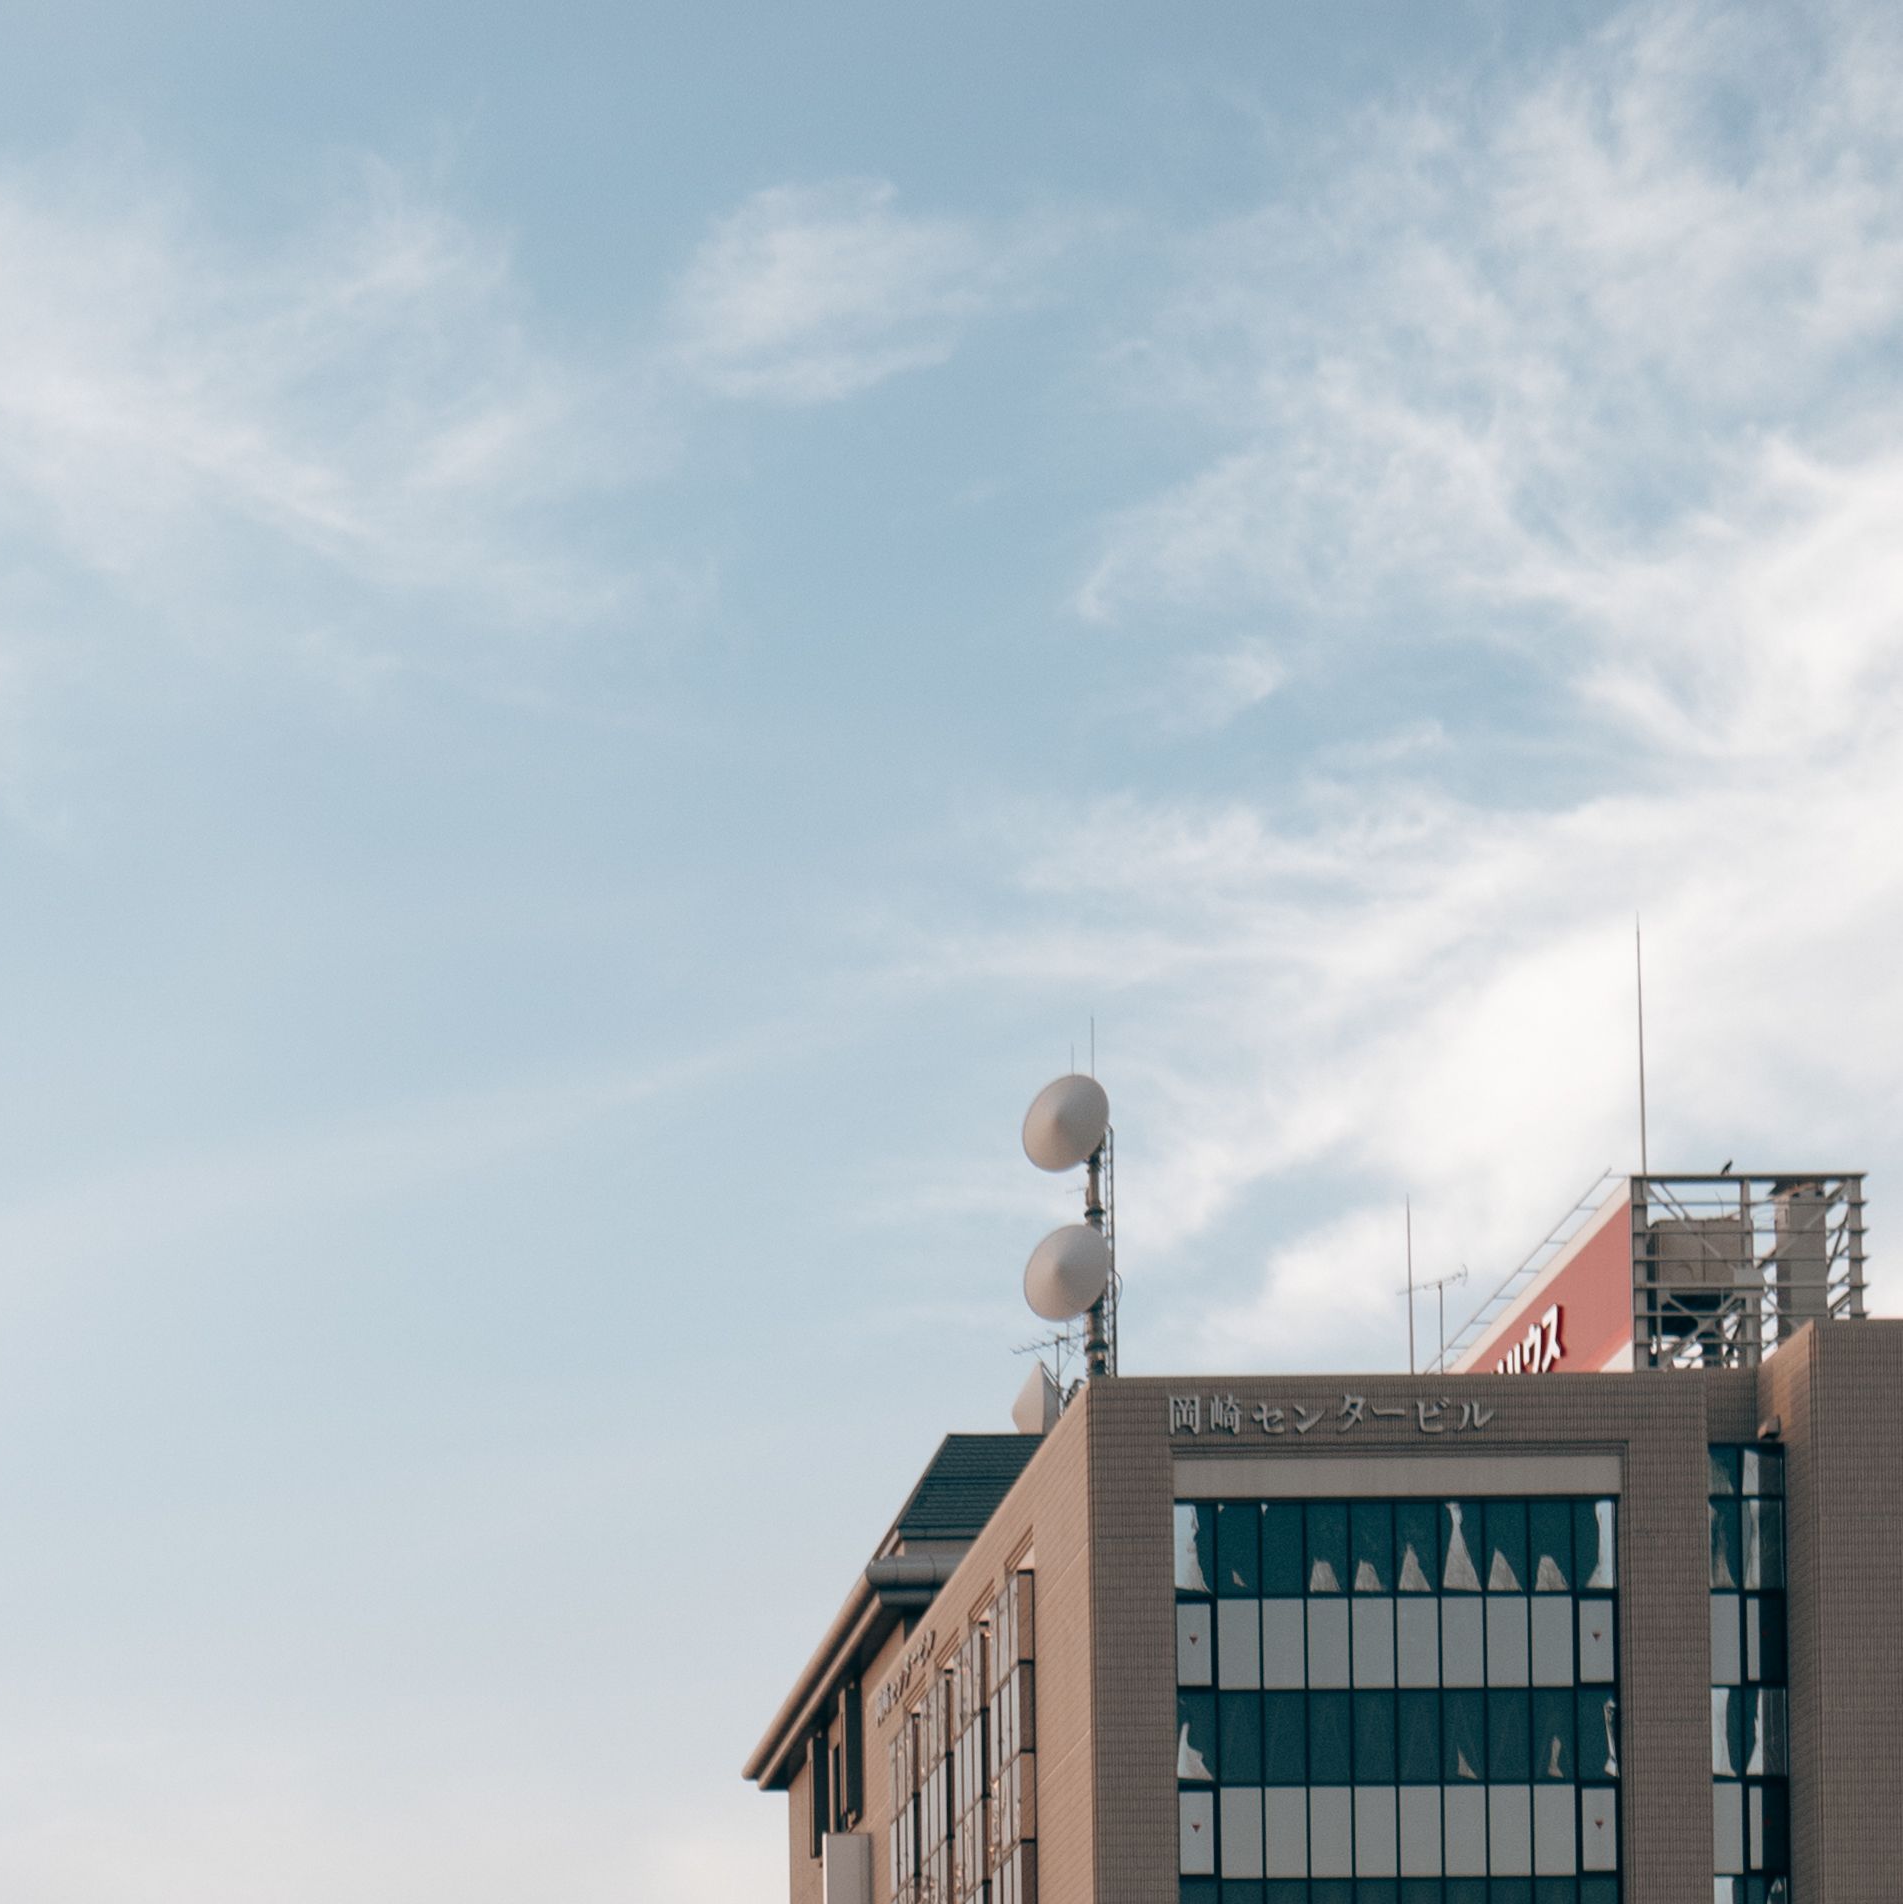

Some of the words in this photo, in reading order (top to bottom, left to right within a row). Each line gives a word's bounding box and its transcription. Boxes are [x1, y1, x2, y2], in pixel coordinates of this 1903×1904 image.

[1168, 1394, 1496, 1435] 岡崎センタービル
